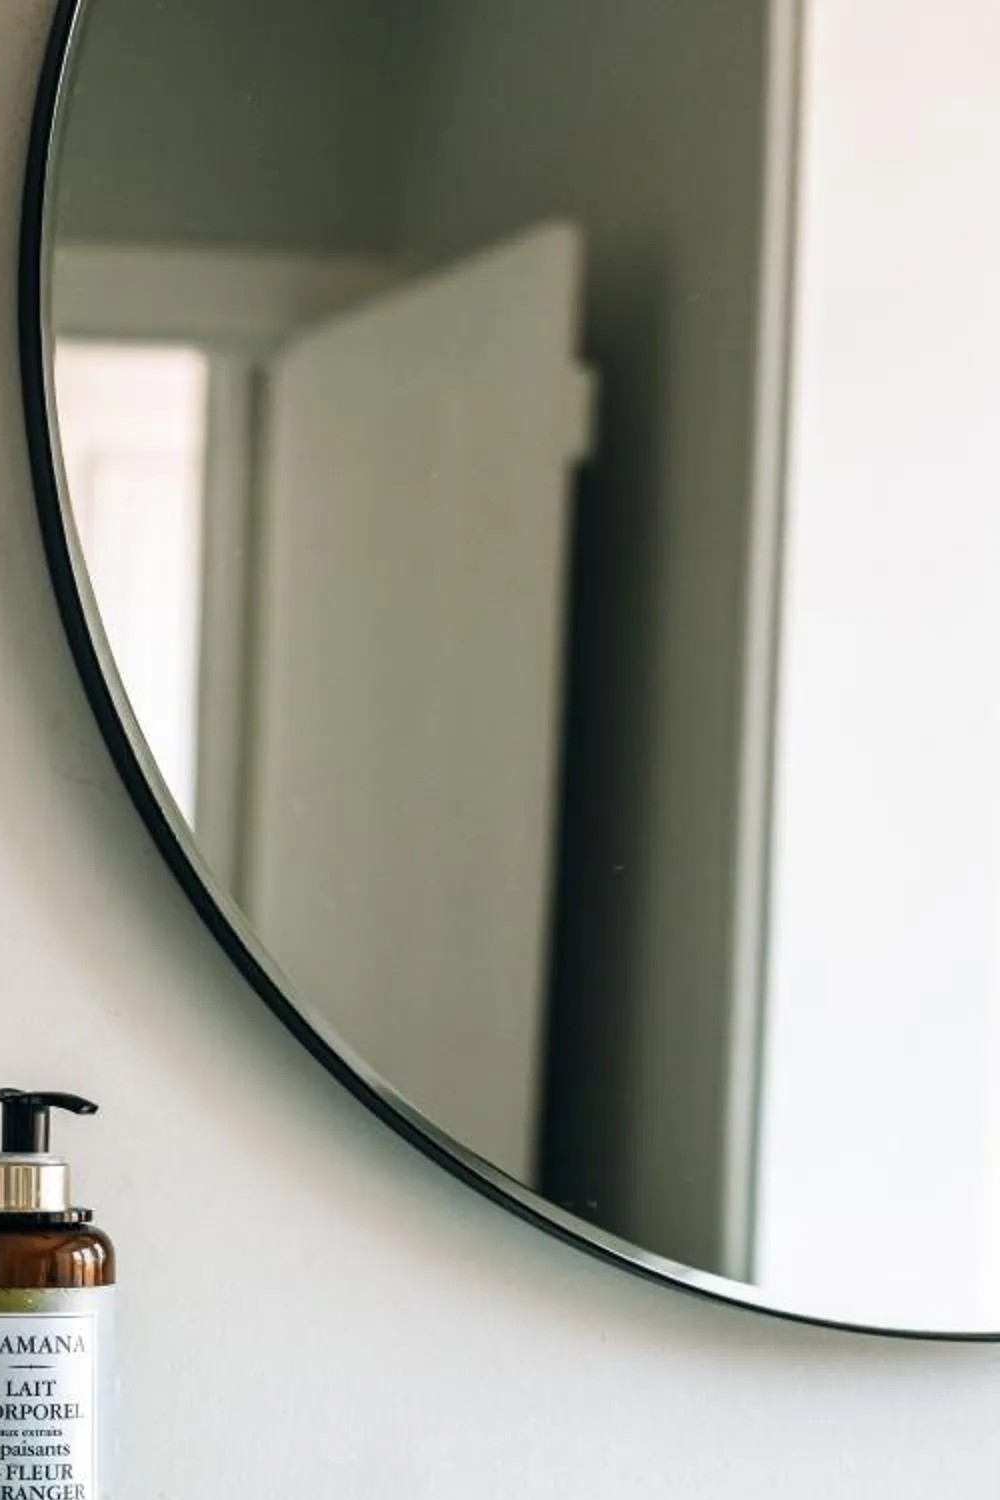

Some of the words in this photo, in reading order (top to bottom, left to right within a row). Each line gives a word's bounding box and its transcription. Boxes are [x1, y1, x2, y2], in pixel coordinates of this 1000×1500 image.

[6, 1380, 57, 1397] LAIT
[22, 1427, 63, 1437] extraits
[6, 1464, 73, 1481] FLEUR
